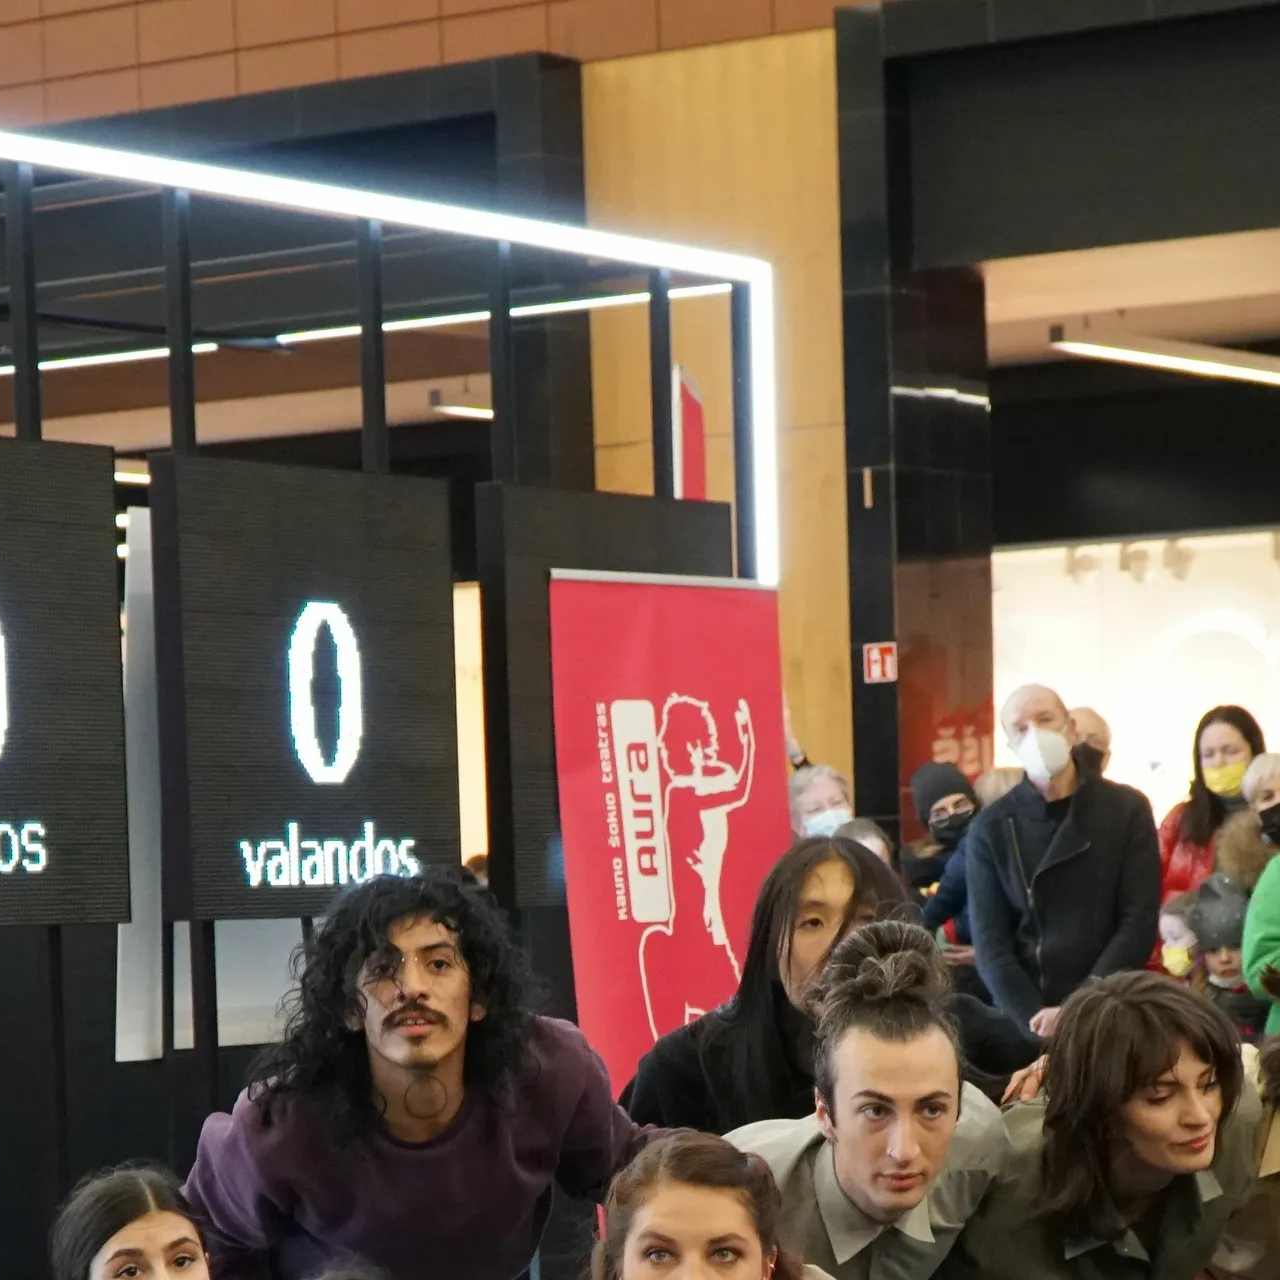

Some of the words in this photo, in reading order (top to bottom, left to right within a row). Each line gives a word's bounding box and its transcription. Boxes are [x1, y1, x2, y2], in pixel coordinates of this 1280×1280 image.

[286, 599, 366, 786] 0
[595, 702, 613, 784] teatras
[239, 821, 419, 886] valandos
